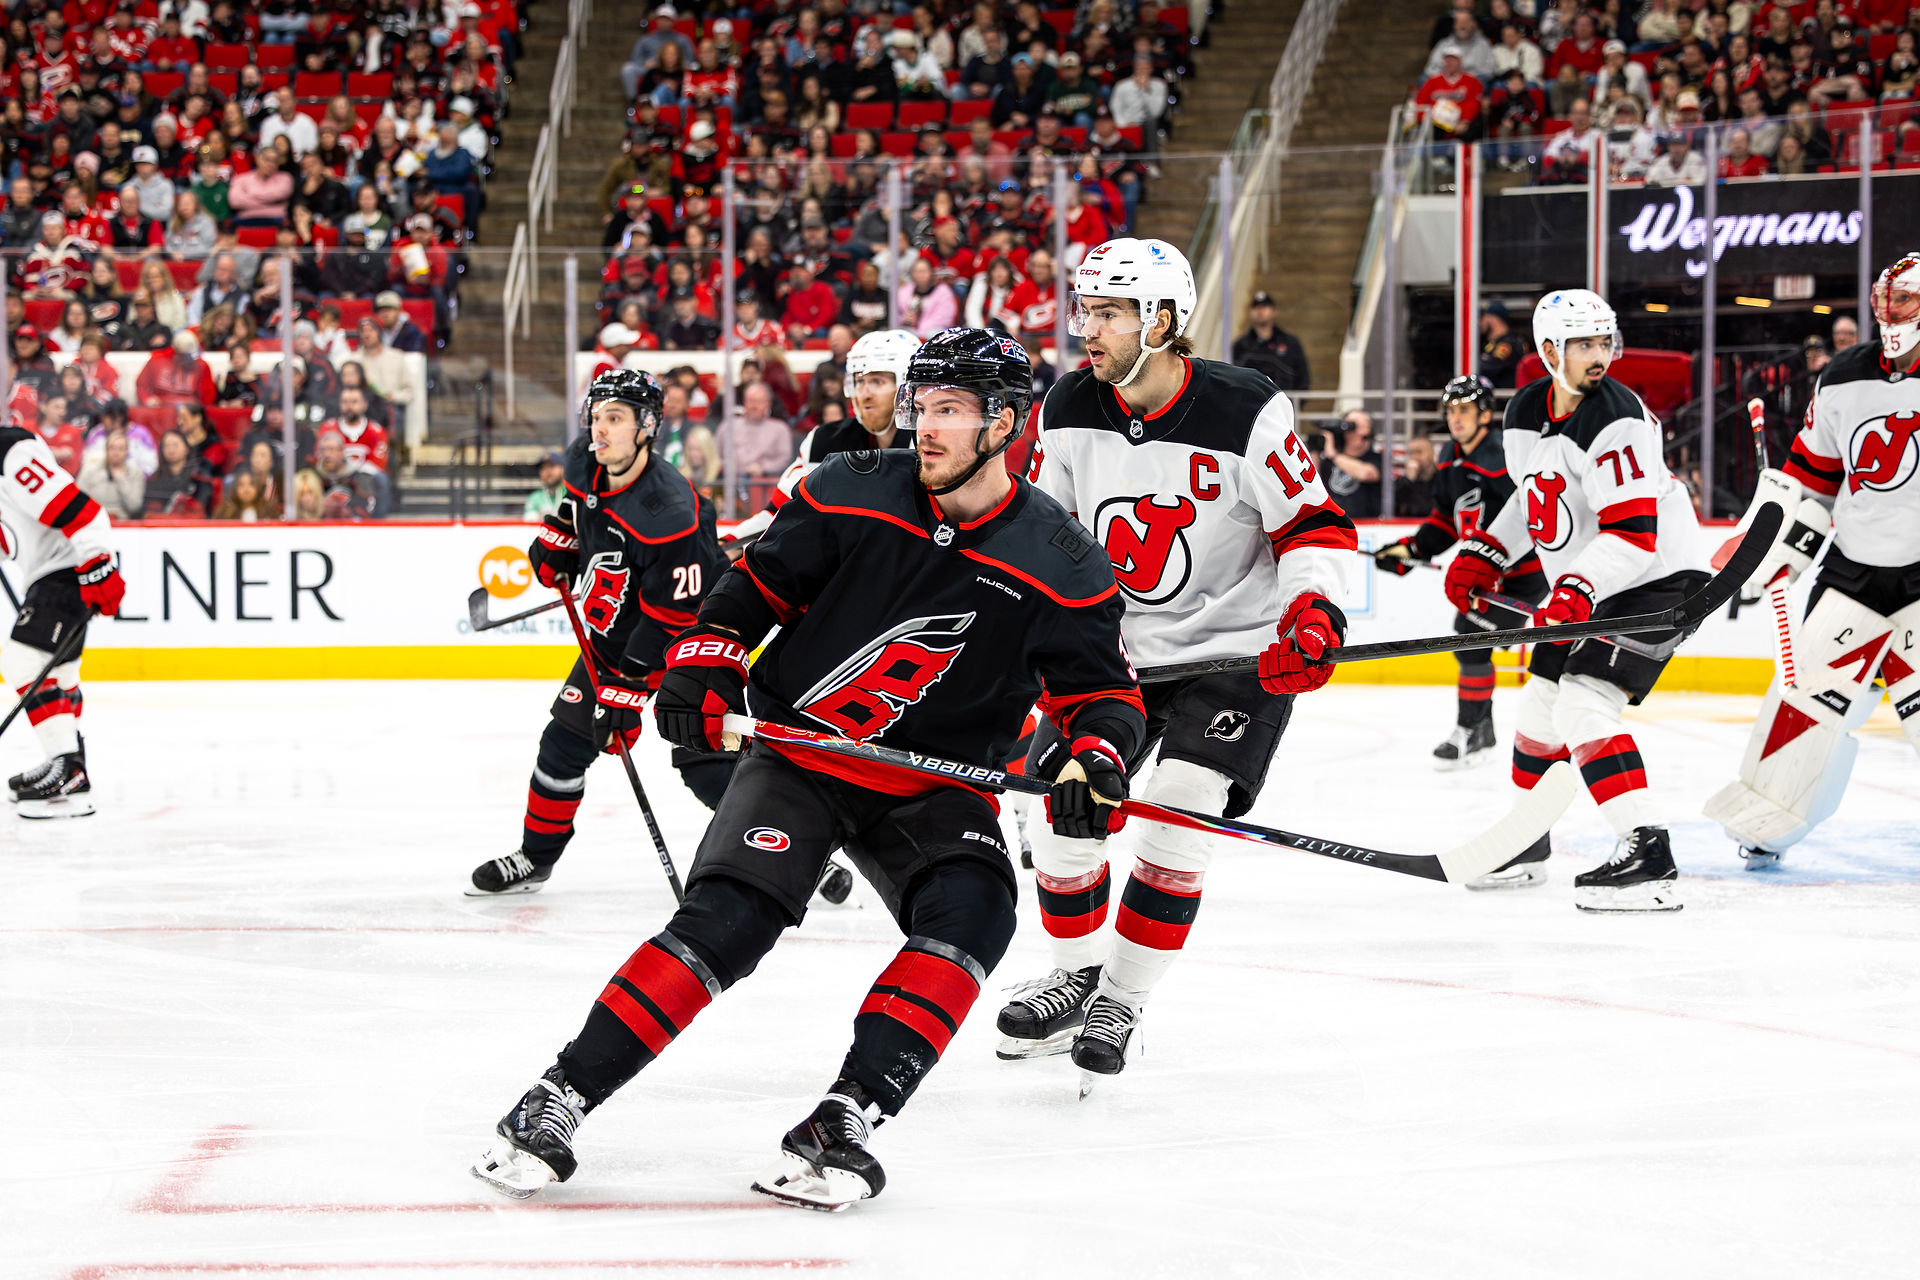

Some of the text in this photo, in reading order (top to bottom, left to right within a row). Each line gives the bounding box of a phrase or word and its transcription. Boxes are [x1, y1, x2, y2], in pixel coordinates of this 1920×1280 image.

[1619, 185, 1863, 277] Wegmans
[14, 458, 55, 494] 91
[1189, 451, 1221, 501] C
[1264, 430, 1317, 500] 13
[1596, 445, 1645, 487] 71
[672, 562, 702, 602] 20
[976, 575, 1022, 601] NUCOR
[456, 617, 539, 636] OCIAL
[1770, 588, 1797, 687] WARRIOR
[920, 757, 1006, 785] BAUER
[1293, 837, 1376, 863] FLYLITE
